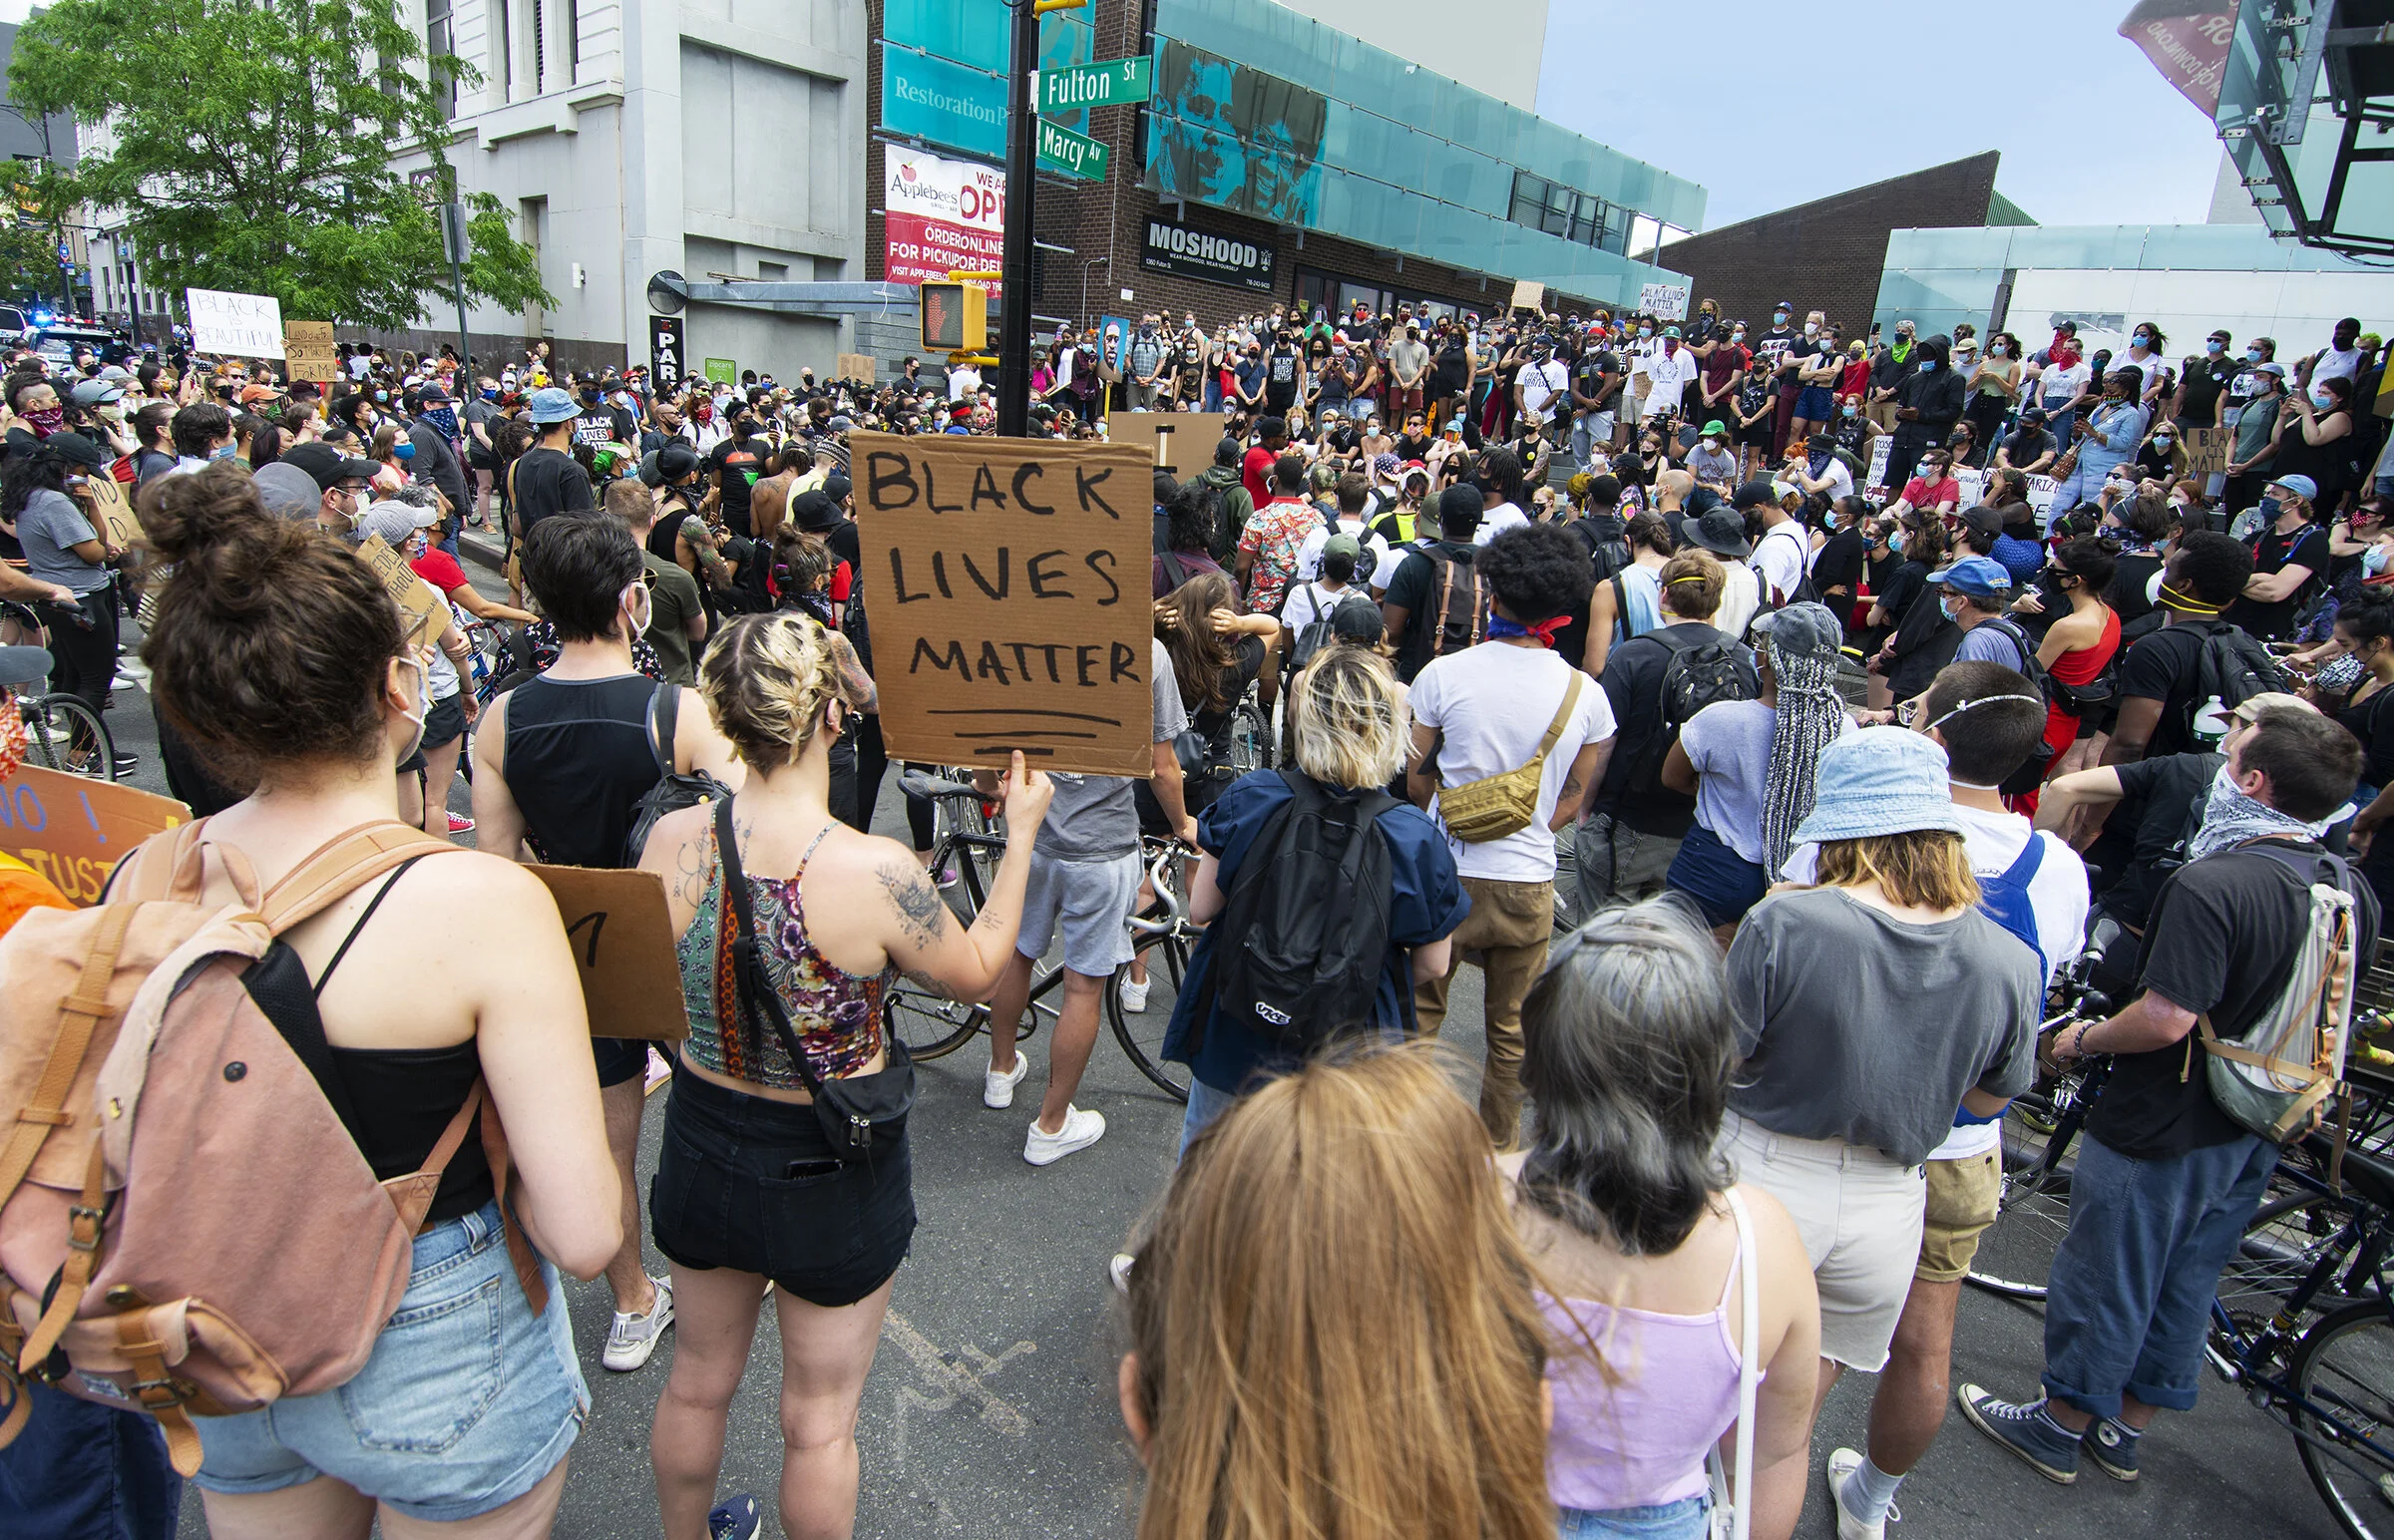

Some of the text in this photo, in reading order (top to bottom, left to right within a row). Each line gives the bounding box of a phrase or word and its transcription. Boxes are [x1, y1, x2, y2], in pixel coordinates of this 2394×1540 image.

[1048, 60, 1136, 105] Fulton St
[895, 76, 1007, 126] RestorationP
[1044, 126, 1101, 172] Marcy Av
[891, 174, 958, 204] Applebee's
[977, 172, 1005, 192] WE AR
[961, 186, 1005, 225] OP
[890, 241, 919, 259] FOR
[1149, 222, 1257, 268] MOSHOOD
[892, 265, 909, 276] VISIT
[1644, 299, 1673, 309] MATTER
[1645, 288, 1683, 301] BLACK LIVES
[196, 293, 274, 320] BLACK
[229, 316, 242, 326] IS
[195, 326, 273, 350] BEAUTIFUL
[1613, 344, 1629, 353] BLA
[658, 332, 677, 386] PAR
[709, 360, 732, 369] zipcars
[840, 356, 875, 378] BLM
[577, 416, 613, 429] BLACK
[582, 429, 607, 440] LIVES
[2199, 430, 2227, 447] BLA
[867, 451, 1119, 520] BLACK
[386, 561, 417, 601] THOUT
[890, 547, 1119, 605] LIVES
[426, 597, 439, 614] GLASS
[910, 637, 1141, 686] MATTER
[1256, 1001, 1291, 1024] VICE
